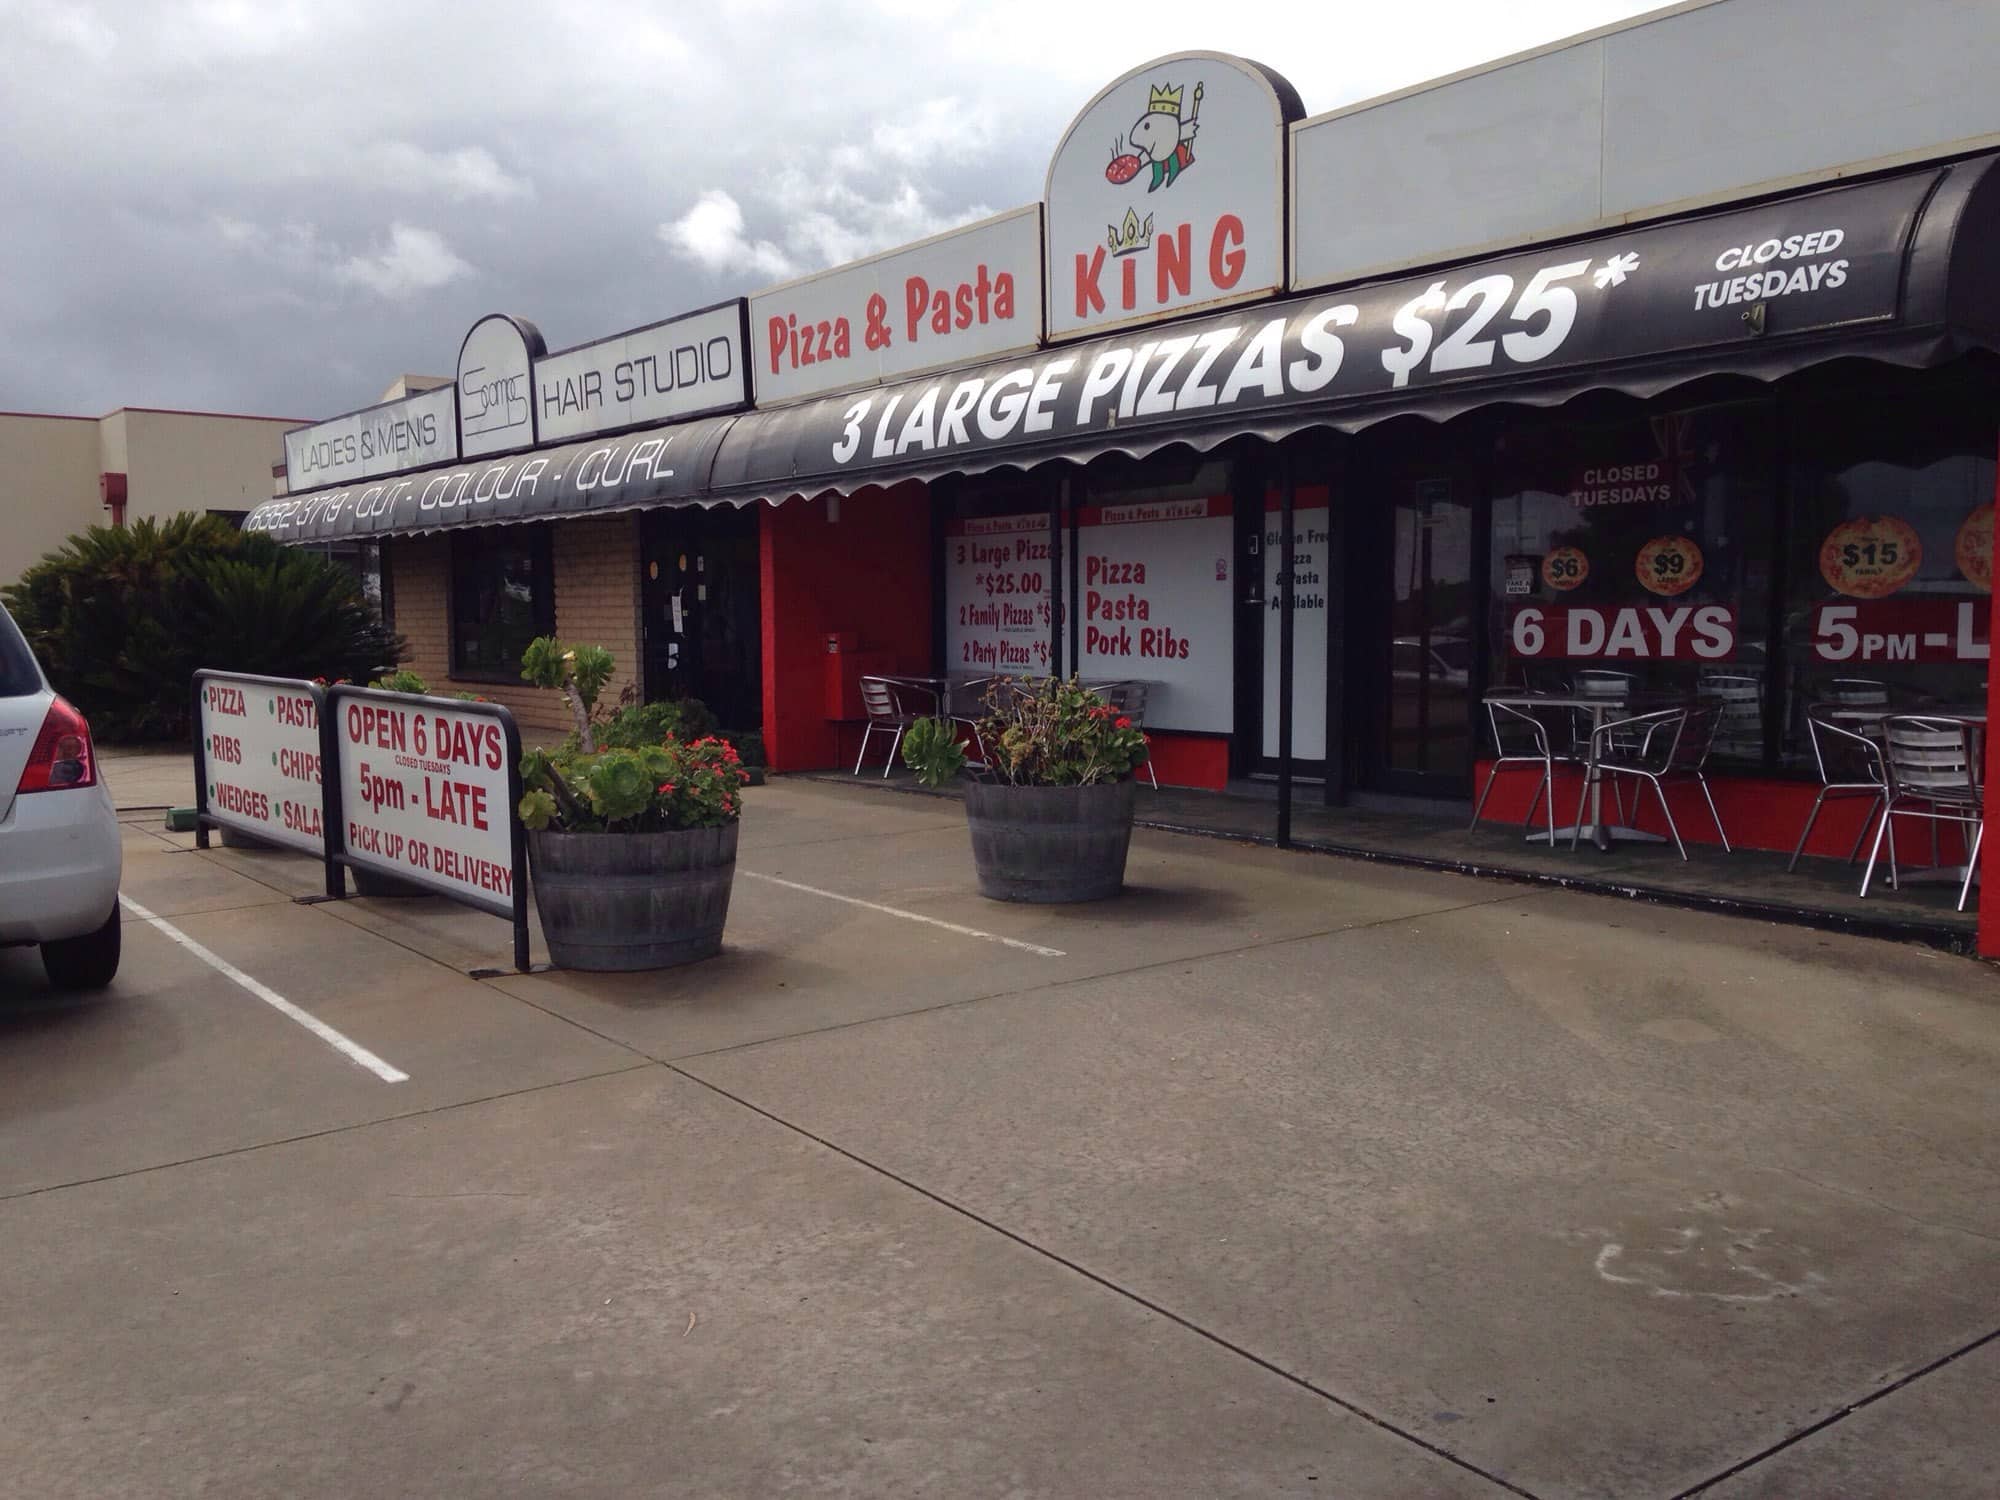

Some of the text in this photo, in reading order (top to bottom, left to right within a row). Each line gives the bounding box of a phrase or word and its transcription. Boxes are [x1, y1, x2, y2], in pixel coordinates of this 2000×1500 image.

[1715, 228, 1845, 272] CLOSED
[1693, 260, 1849, 311] TUESDAYS
[769, 264, 1015, 374] Pizza & Pasta
[543, 337, 732, 419] HAIR STUDIO
[832, 399, 863, 465] 3
[872, 358, 1078, 459] LARGE
[1076, 304, 1361, 425] PIZZAS
[300, 413, 437, 473] LADIES & MEN'S
[356, 482, 412, 518] CUT
[420, 458, 542, 510] COLOUR
[576, 438, 674, 491] CURL
[1584, 463, 1659, 485] CLOSED
[1571, 485, 1671, 507] TUESDAYS
[1266, 529, 1303, 545] Gln
[957, 544, 966, 564] 3
[972, 541, 1010, 569] Large
[1086, 555, 1146, 586] Pizza
[1552, 558, 1579, 580] $6
[1654, 553, 1684, 576] $9
[1842, 543, 1898, 568] $15
[1293, 571, 1319, 584] asta
[960, 605, 966, 625] 2
[969, 602, 1000, 632] Family
[1003, 602, 1033, 626] Pizzas
[1086, 591, 1149, 621] Pasta
[1271, 594, 1324, 610] Ailable
[1086, 626, 1190, 660] Pork Ribs
[1512, 606, 1734, 658] 6 DAYS
[963, 641, 969, 662] 2
[973, 640, 997, 669] Party
[1000, 640, 1030, 664] Pizzas
[209, 686, 246, 717] PIZZA
[213, 734, 242, 765] RIBS
[348, 703, 502, 771] OPEN 6 DAYS
[281, 749, 322, 785] CHIPS
[395, 754, 451, 776] CLOSED TUESDAYS
[216, 782, 269, 822] WEDGES
[360, 762, 404, 814] 5pm
[424, 776, 488, 832] LATE
[284, 800, 322, 838] SALA
[350, 822, 512, 897] PICK UP OR DELIVERY
